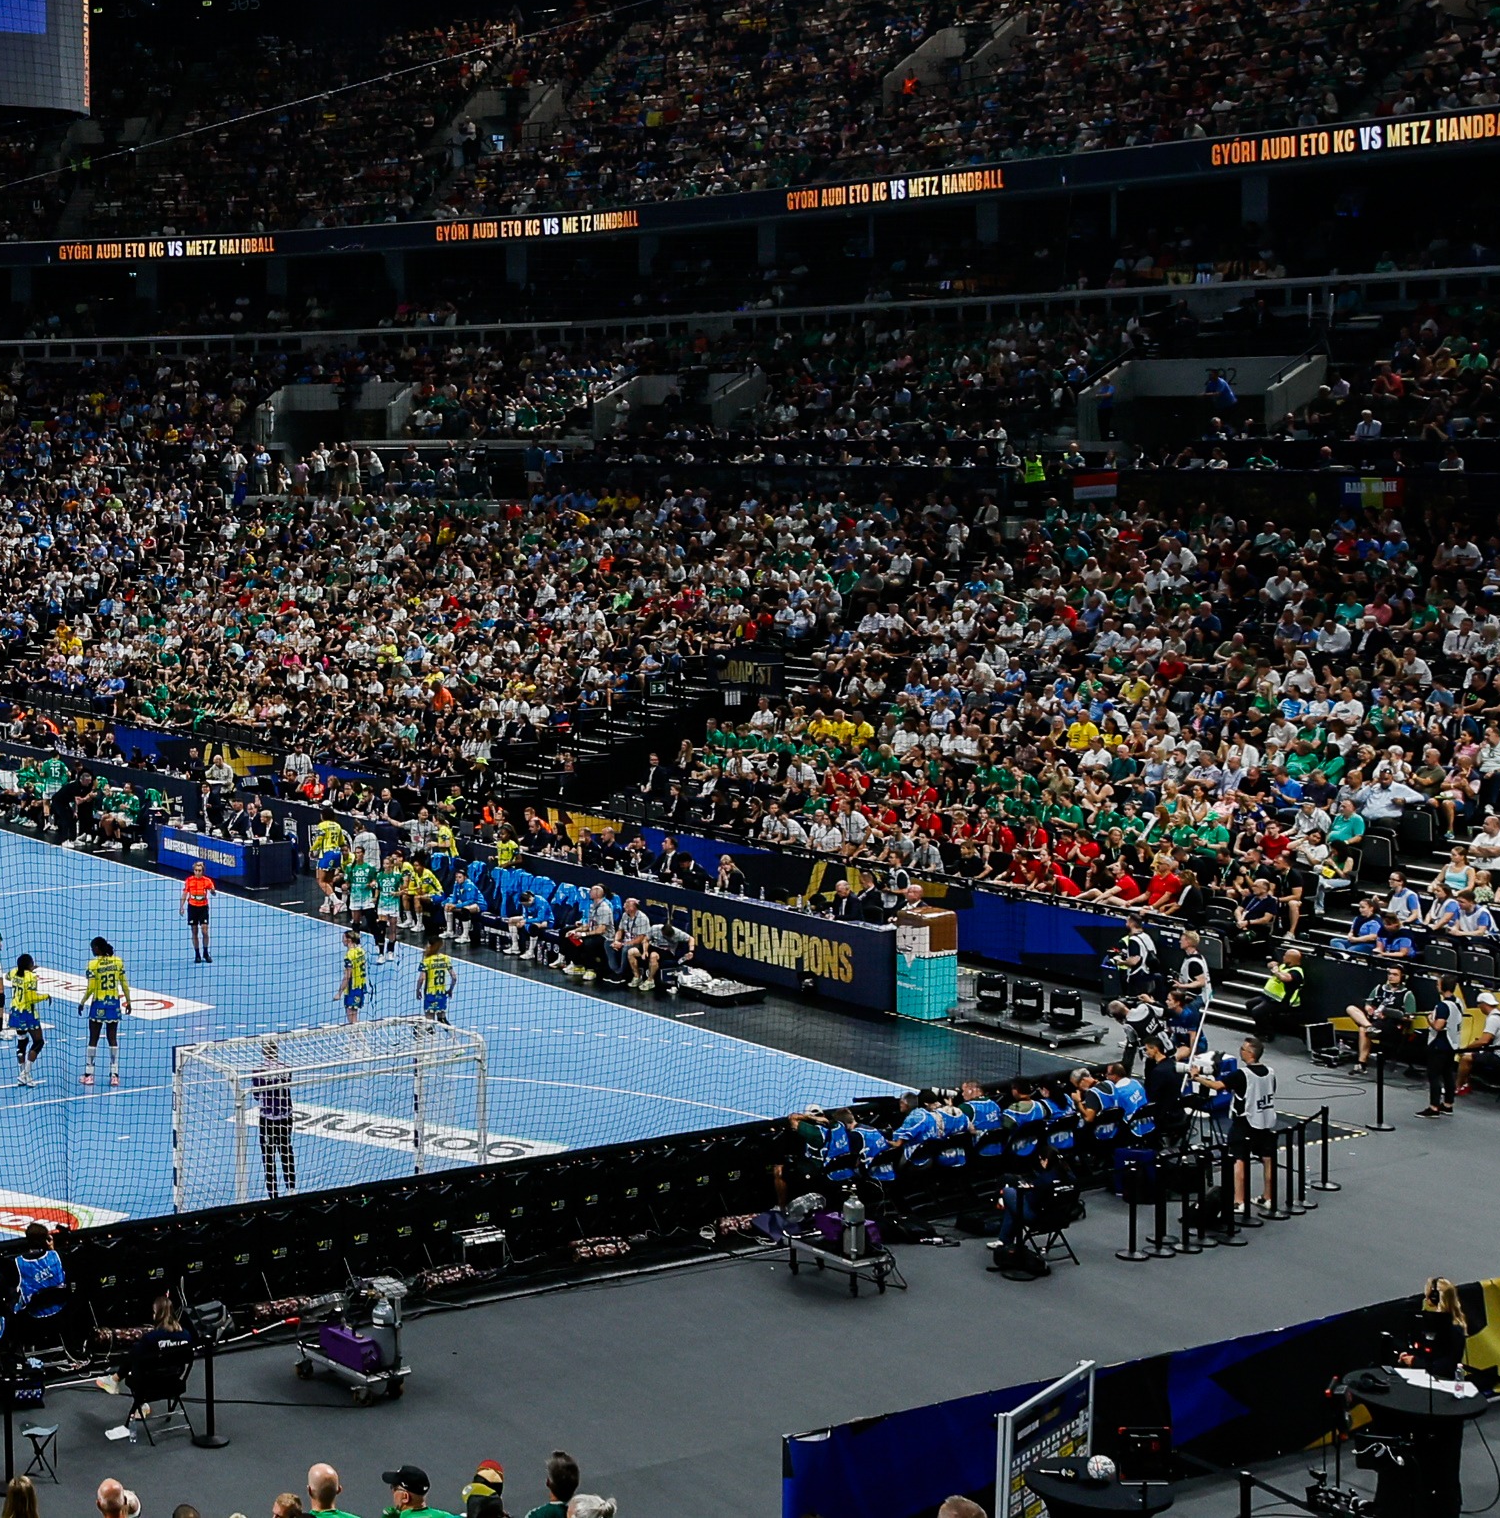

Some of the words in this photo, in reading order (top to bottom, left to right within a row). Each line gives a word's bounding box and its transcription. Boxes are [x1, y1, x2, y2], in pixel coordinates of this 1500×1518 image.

[1261, 136, 1296, 160] AUDI
[1301, 132, 1329, 156] ETO
[1334, 129, 1355, 153] KC
[1360, 126, 1382, 150] VS
[1387, 120, 1431, 147] METZ
[822, 186, 846, 206] AUDI
[849, 184, 869, 204] ETO
[873, 182, 887, 201] KC
[890, 180, 905, 199] VS
[909, 176, 938, 198] METZ
[942, 169, 1003, 194] HANDBALL
[473, 222, 497, 239] AUDI
[501, 220, 521, 237] ETO
[525, 219, 540, 236] KC
[543, 218, 559, 235] VS
[594, 211, 638, 231] HANDBALL
[96, 244, 121, 258] AUDI
[125, 243, 145, 257] ETO
[149, 242, 164, 257] KC
[167, 241, 183, 256] VS
[186, 240, 216, 256] METZ
[50, 767, 60, 778] 15
[692, 909, 729, 950] FOR
[731, 918, 855, 984] CHAMPIONS
[101, 973, 116, 991] 23
[433, 970, 446, 986] 28
